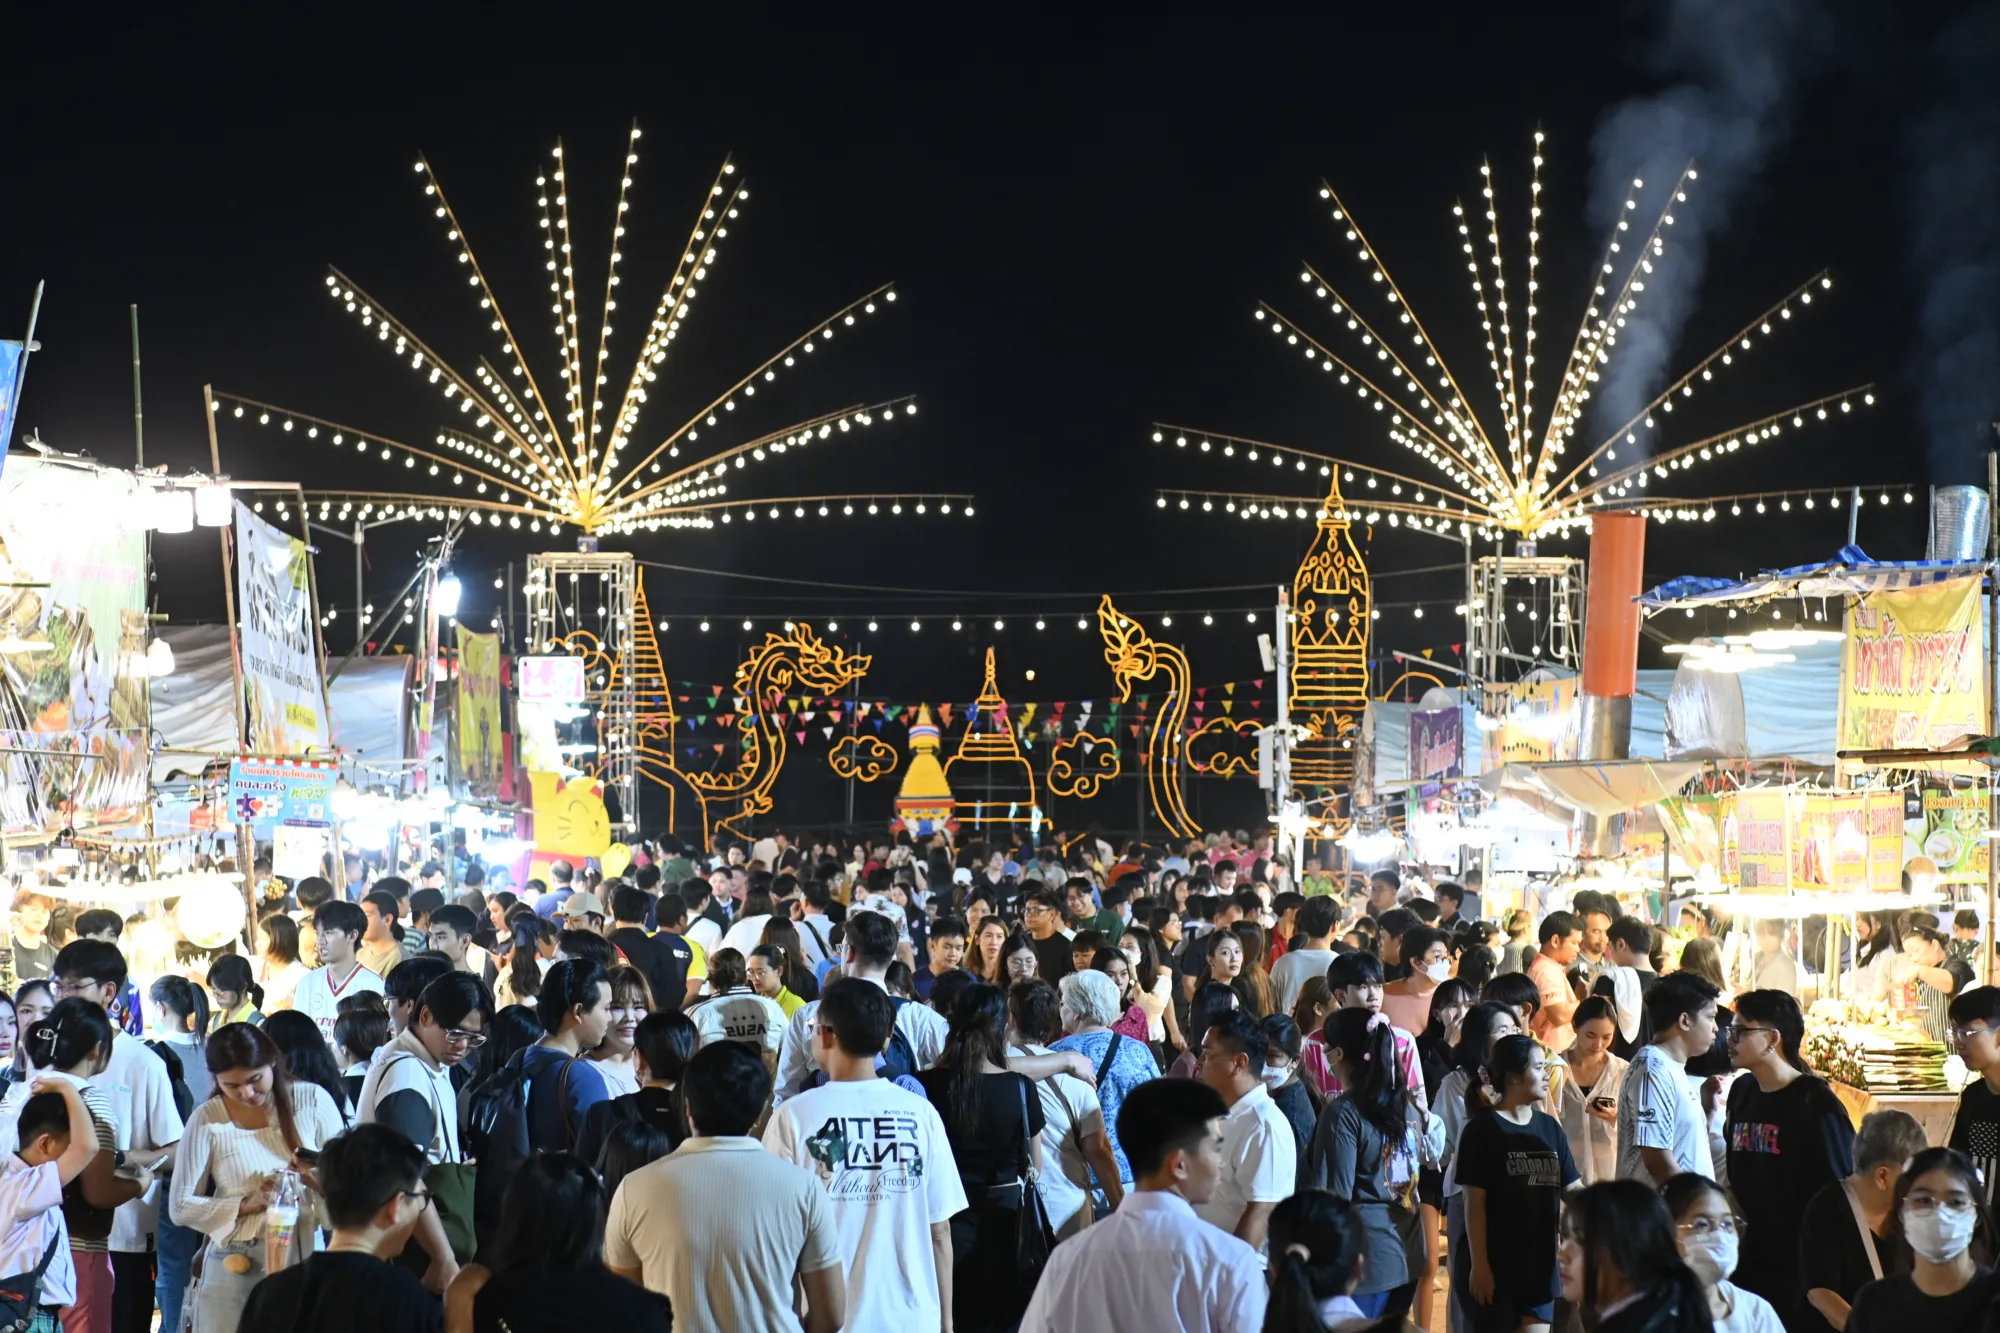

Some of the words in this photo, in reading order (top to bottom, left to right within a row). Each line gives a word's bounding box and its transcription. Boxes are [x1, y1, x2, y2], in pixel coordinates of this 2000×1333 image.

[235, 778, 287, 792] คนละครึ่ง
[1732, 1122, 1781, 1154] MARVEL
[856, 1193, 891, 1202] CREATION
